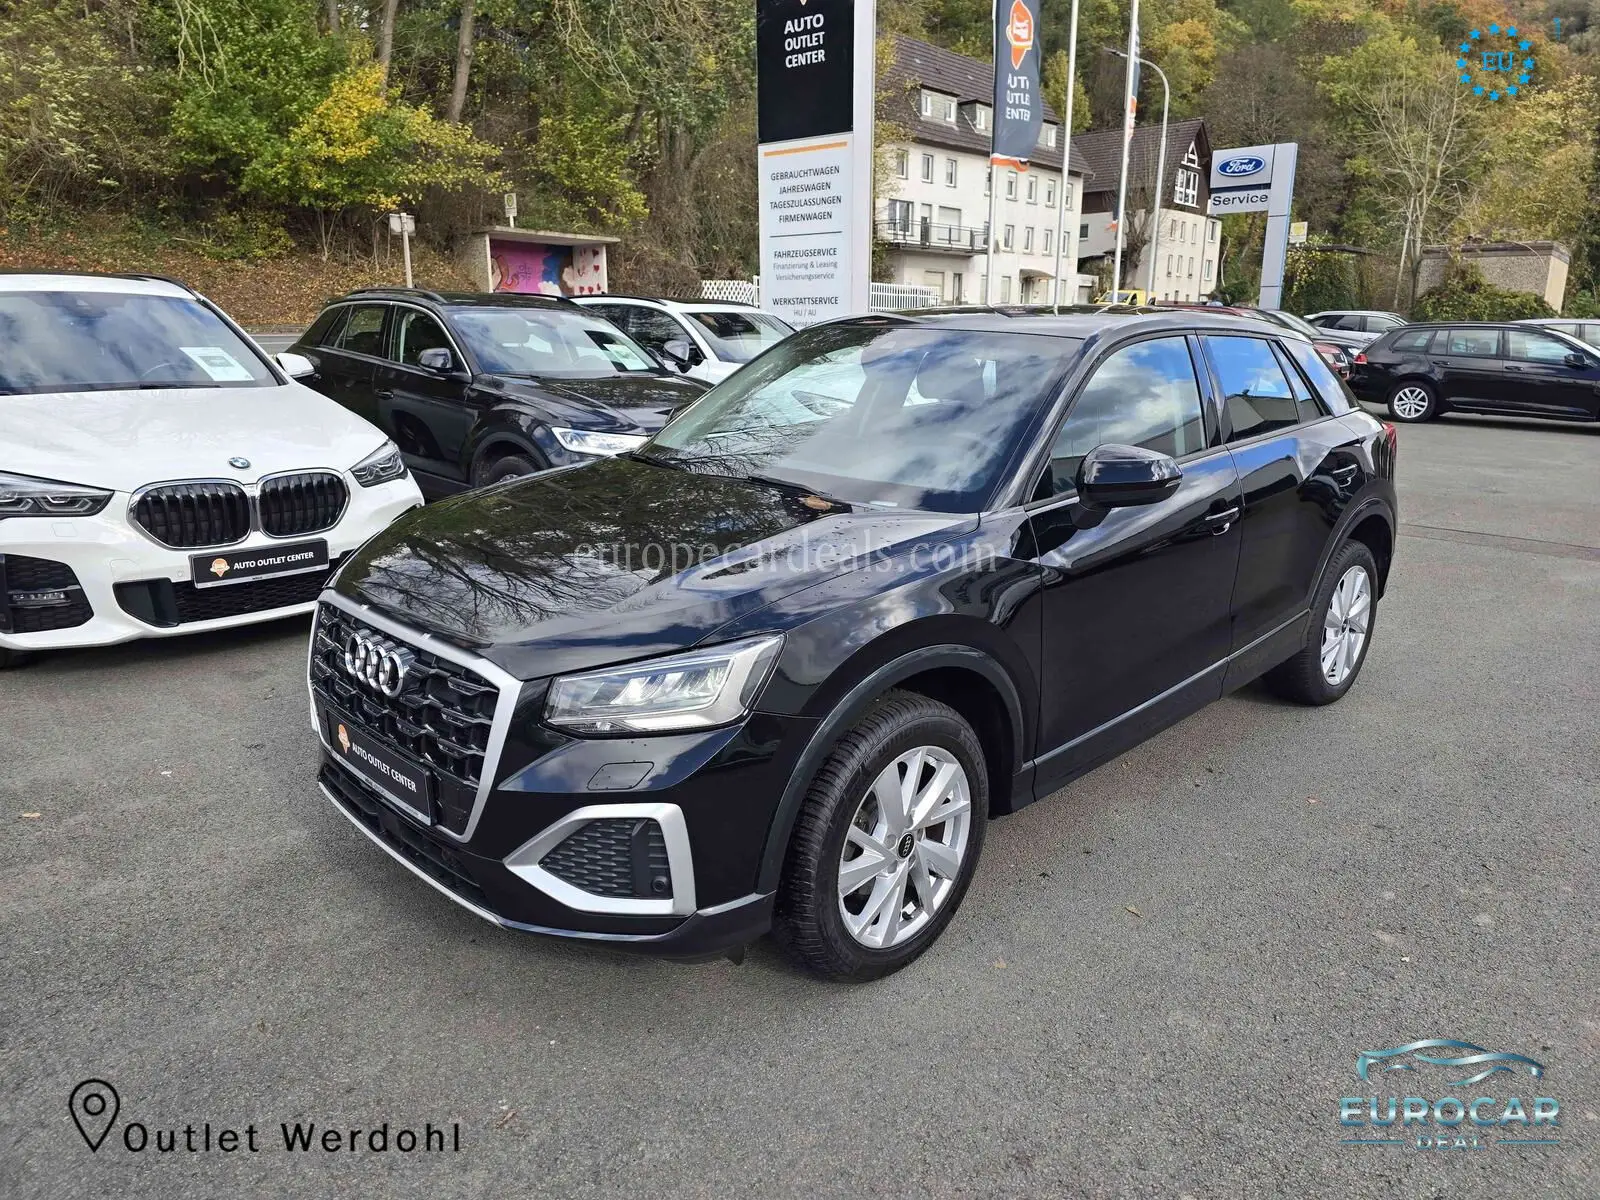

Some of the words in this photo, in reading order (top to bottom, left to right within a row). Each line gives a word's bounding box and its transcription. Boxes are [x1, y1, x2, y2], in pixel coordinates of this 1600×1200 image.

[784, 14, 824, 34] AUTO
[785, 32, 825, 51] OUTLET
[785, 49, 825, 68] CENTER
[1226, 159, 1256, 173] Ford
[771, 166, 840, 181] GEBRAUCHTWAGEN
[779, 182, 831, 195] JAHRESWAGEN
[770, 196, 842, 210] TAGESZULASSUNGEN
[1212, 193, 1269, 206] Service
[779, 211, 833, 223] FIRMENWAGEN
[774, 248, 837, 259] FAHRZEUGSERVICE
[773, 262, 808, 270] Finanzierung
[816, 260, 838, 269] Leasing
[776, 272, 835, 281] Versicherungsservice
[772, 297, 839, 306] WERKSTATTSERVICE
[233, 560, 256, 570] AUTO
[257, 556, 285, 567] OUTLET
[286, 551, 315, 562] CENTER
[352, 742, 367, 760] AUTO
[367, 753, 390, 776] OUTLET
[391, 768, 417, 793] CENTER
